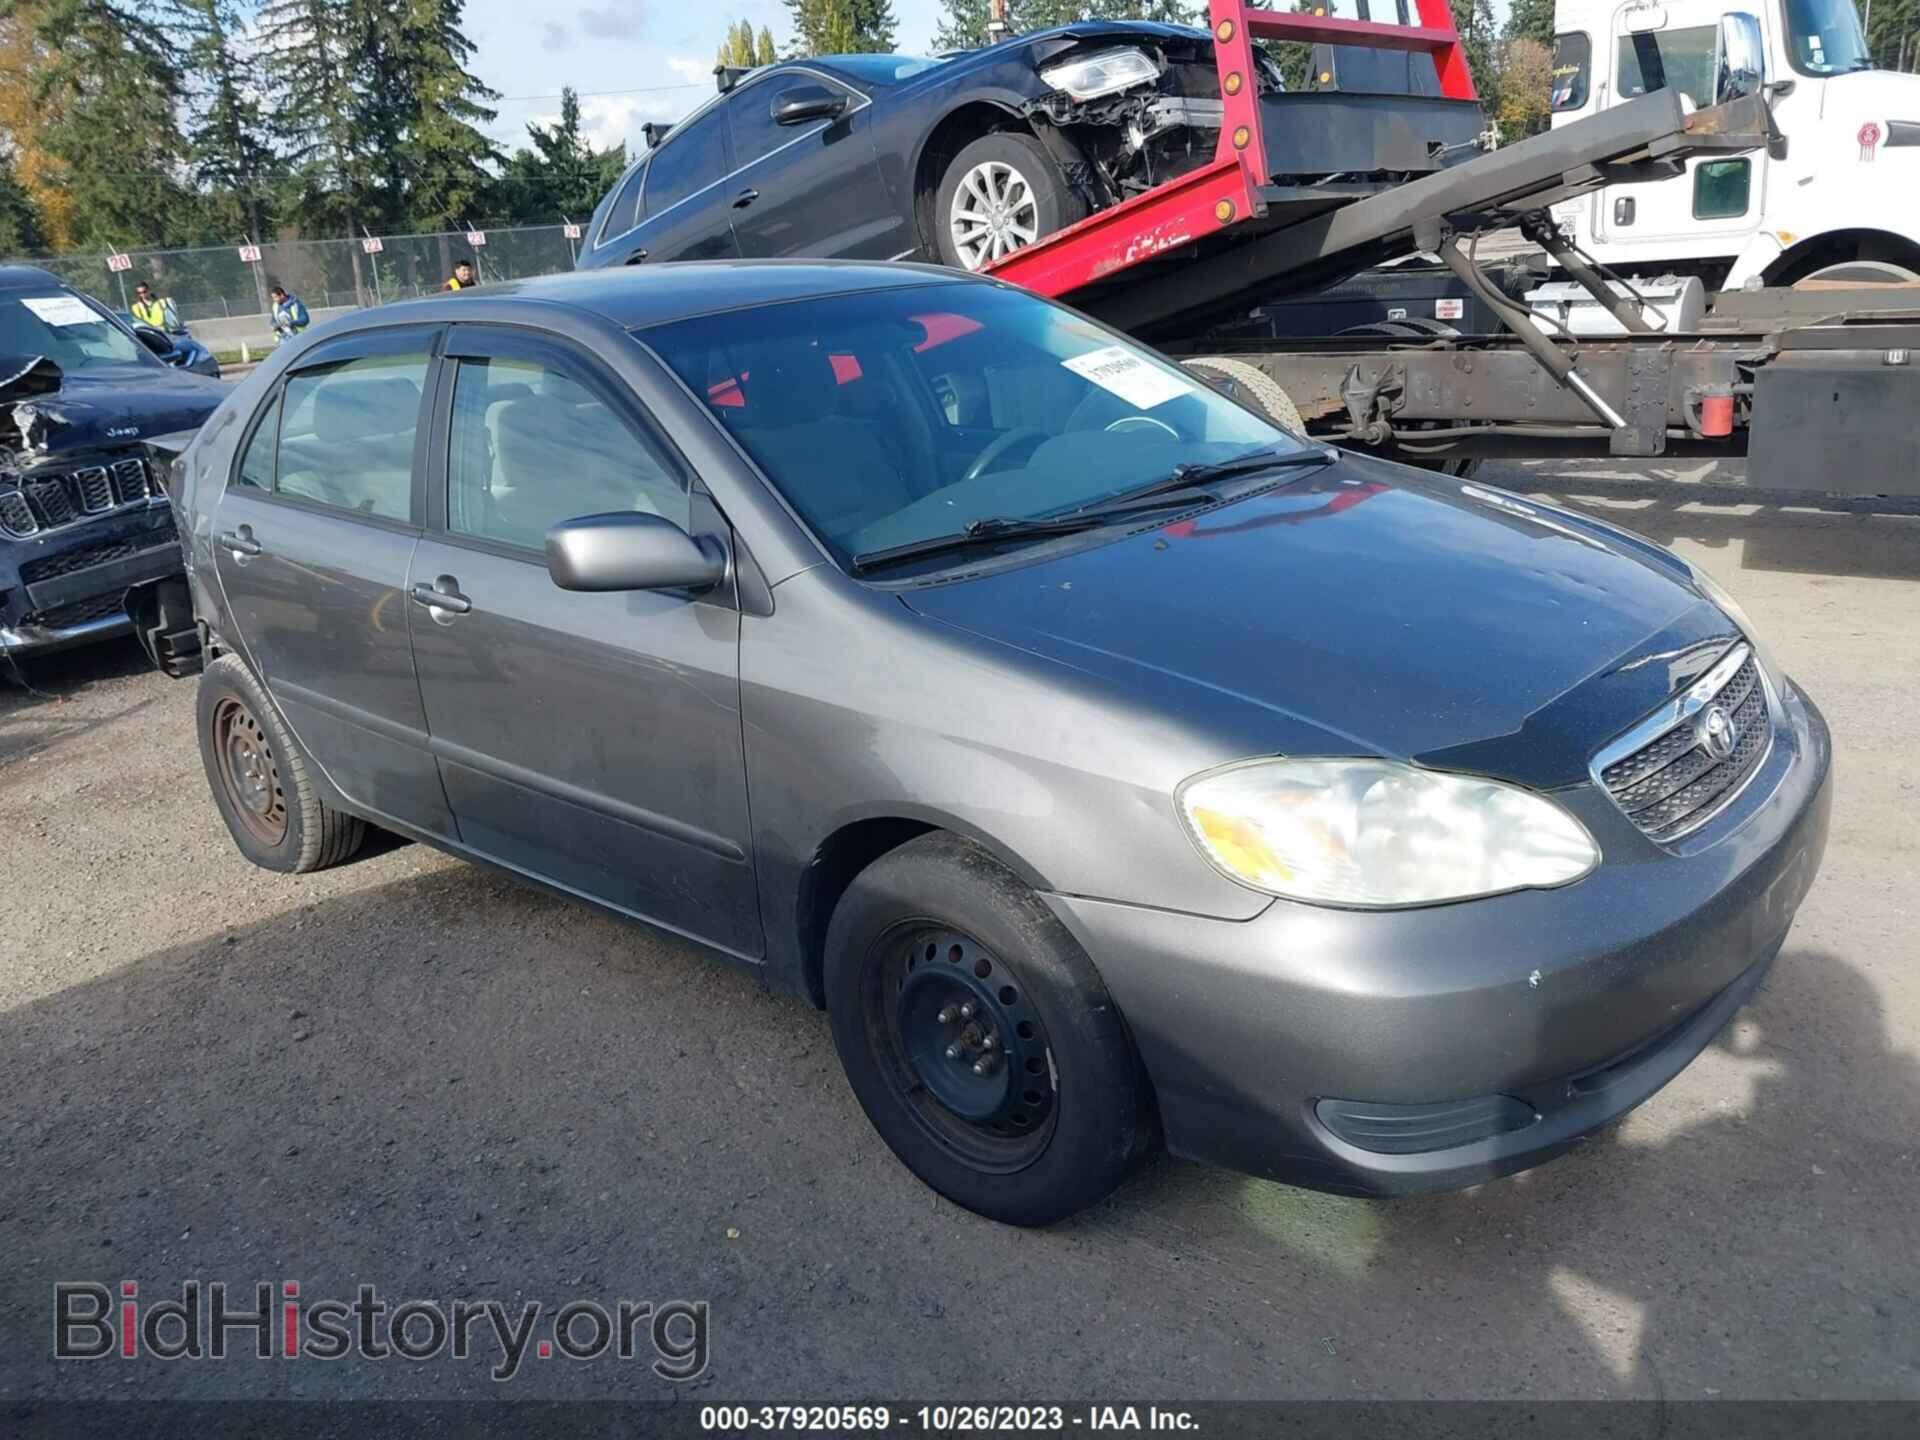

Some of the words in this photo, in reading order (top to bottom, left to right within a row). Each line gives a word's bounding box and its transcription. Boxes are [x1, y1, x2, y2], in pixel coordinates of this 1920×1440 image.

[366, 239, 381, 251] 22
[242, 247, 258, 261] 21
[111, 255, 129, 271] 20
[106, 427, 139, 437] Jeep
